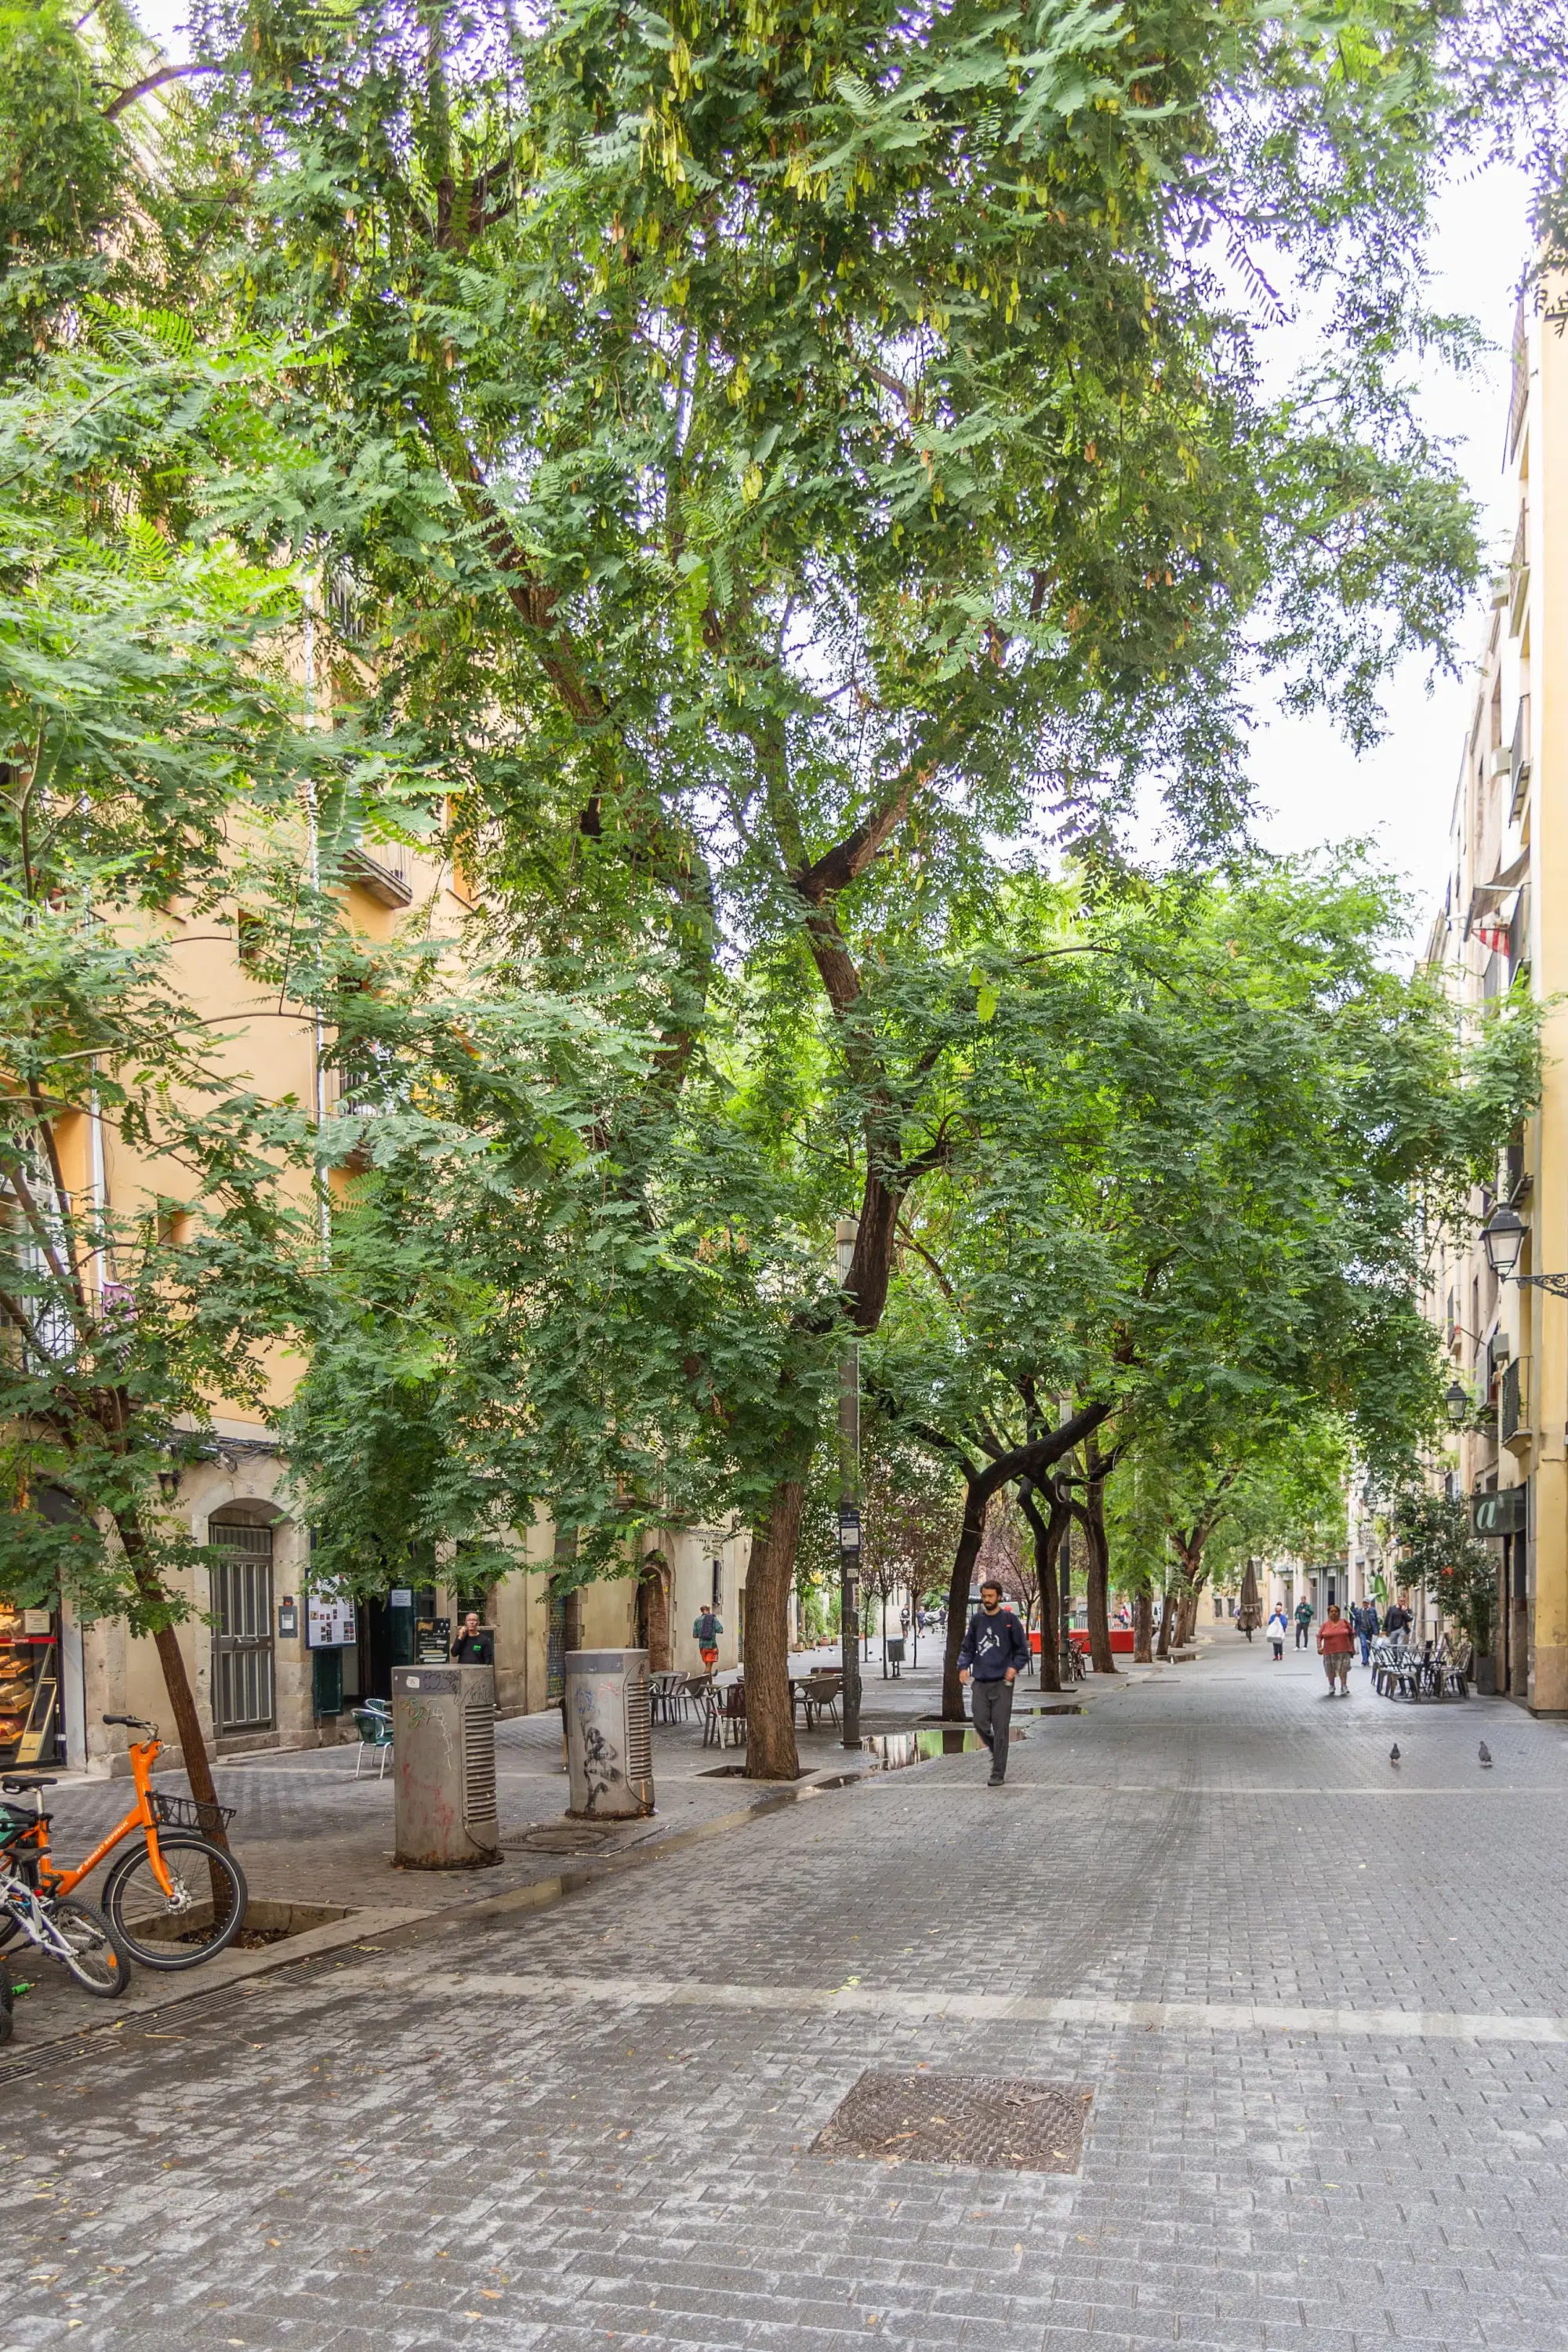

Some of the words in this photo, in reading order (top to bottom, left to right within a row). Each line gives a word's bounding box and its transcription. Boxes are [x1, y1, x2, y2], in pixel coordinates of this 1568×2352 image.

[1477, 1501, 1496, 1529] a
[85, 1844, 103, 1866] DONKEY
[104, 1820, 129, 1845] REPUBLIC
